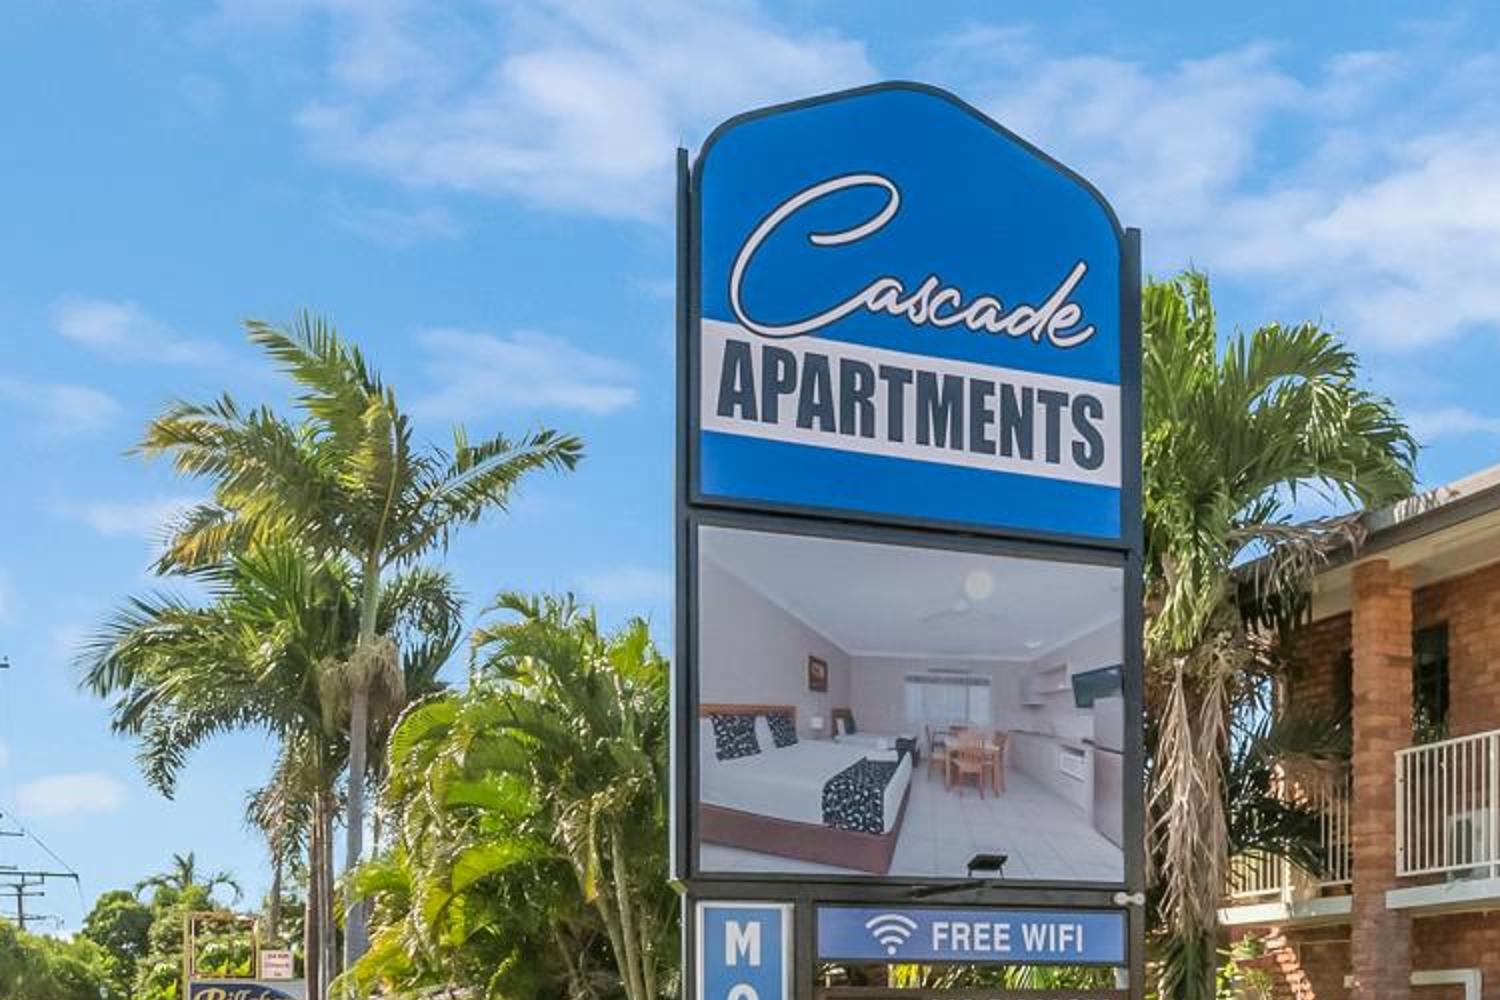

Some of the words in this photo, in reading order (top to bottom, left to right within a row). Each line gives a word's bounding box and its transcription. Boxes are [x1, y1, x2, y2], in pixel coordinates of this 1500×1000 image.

[730, 172, 1097, 348] Cascade
[716, 338, 1106, 472] APARTMENTS
[932, 921, 1011, 951] FREE
[1021, 923, 1084, 953] WIFI
